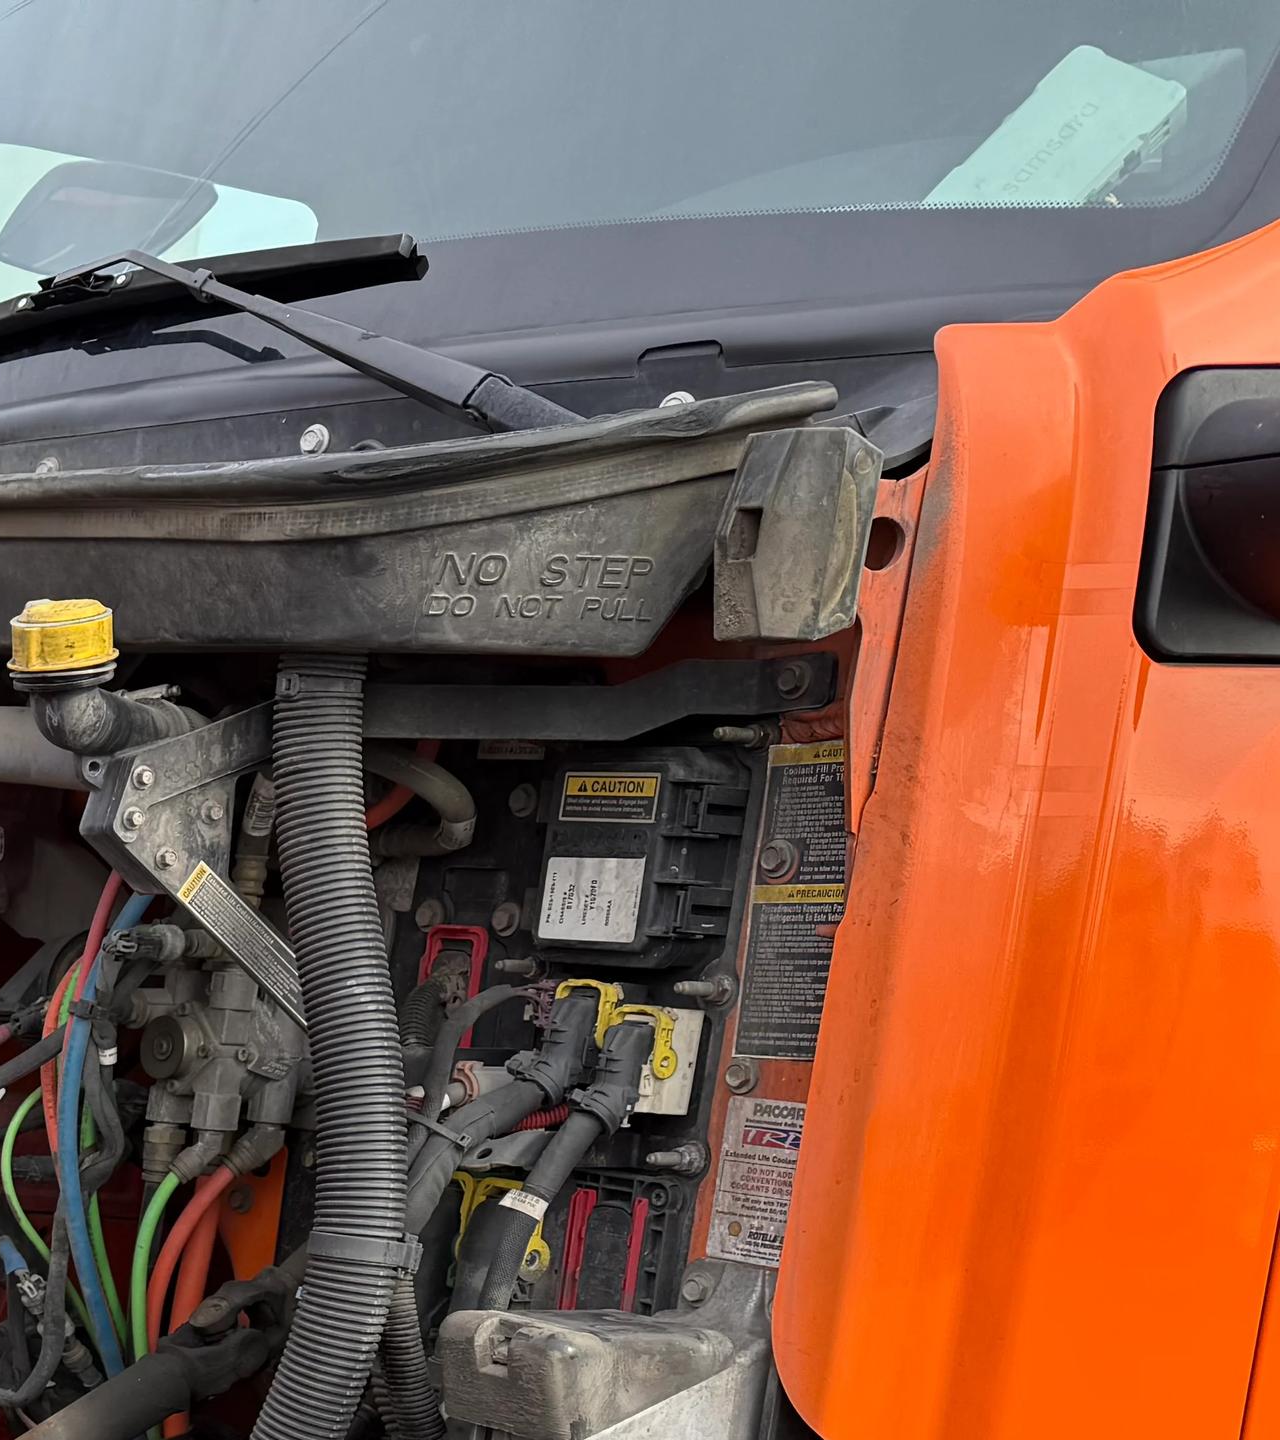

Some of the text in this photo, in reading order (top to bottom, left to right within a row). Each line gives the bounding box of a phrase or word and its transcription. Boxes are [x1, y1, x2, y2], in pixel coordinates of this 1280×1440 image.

[1002, 102, 1099, 195] samsara
[435, 552, 656, 589] NO STEP
[423, 594, 653, 621] DO NOT PULL
[783, 766, 814, 775] Coolant
[782, 774, 817, 785] Required
[820, 773, 833, 782] For
[591, 781, 645, 793] CAUTION
[183, 868, 207, 898] CAUTION
[753, 1103, 806, 1120] PACCAR
[725, 1150, 756, 1160] Extended
[760, 1168, 774, 1177] NOT
[777, 1170, 793, 1179] ADD
[731, 1182, 769, 1193] COOLANTS
[772, 1187, 783, 1196] OR
